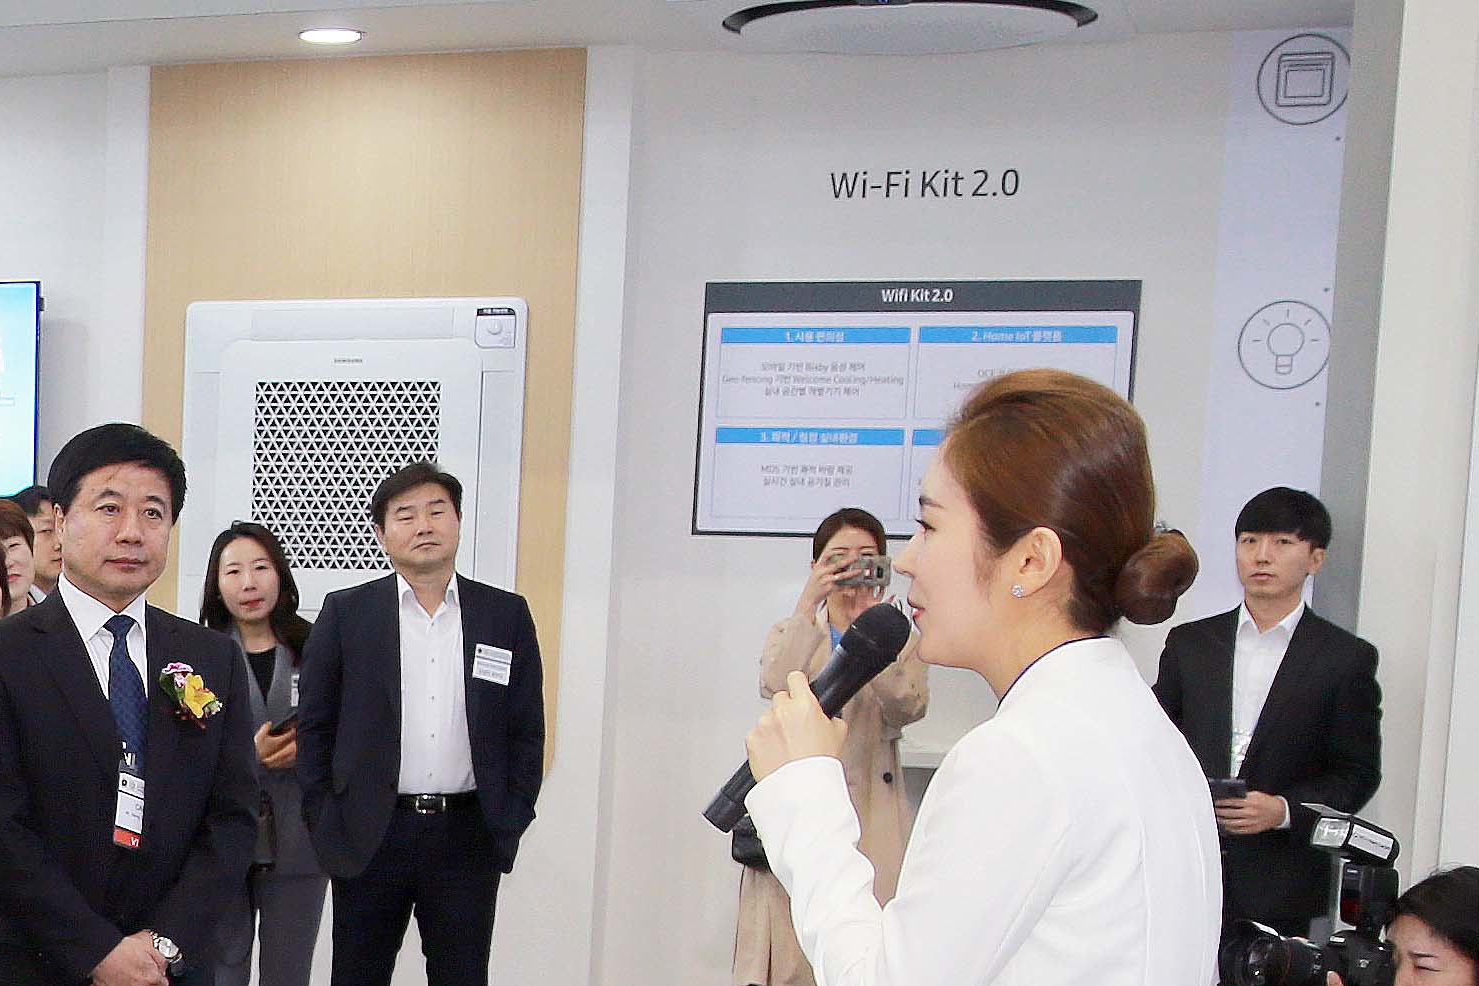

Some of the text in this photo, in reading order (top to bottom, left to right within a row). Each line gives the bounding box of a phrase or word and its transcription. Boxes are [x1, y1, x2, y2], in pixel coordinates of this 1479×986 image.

[830, 168, 1020, 199] Wi-Fi Kit 2.0
[880, 288, 954, 303] Wifi Kit 2.0
